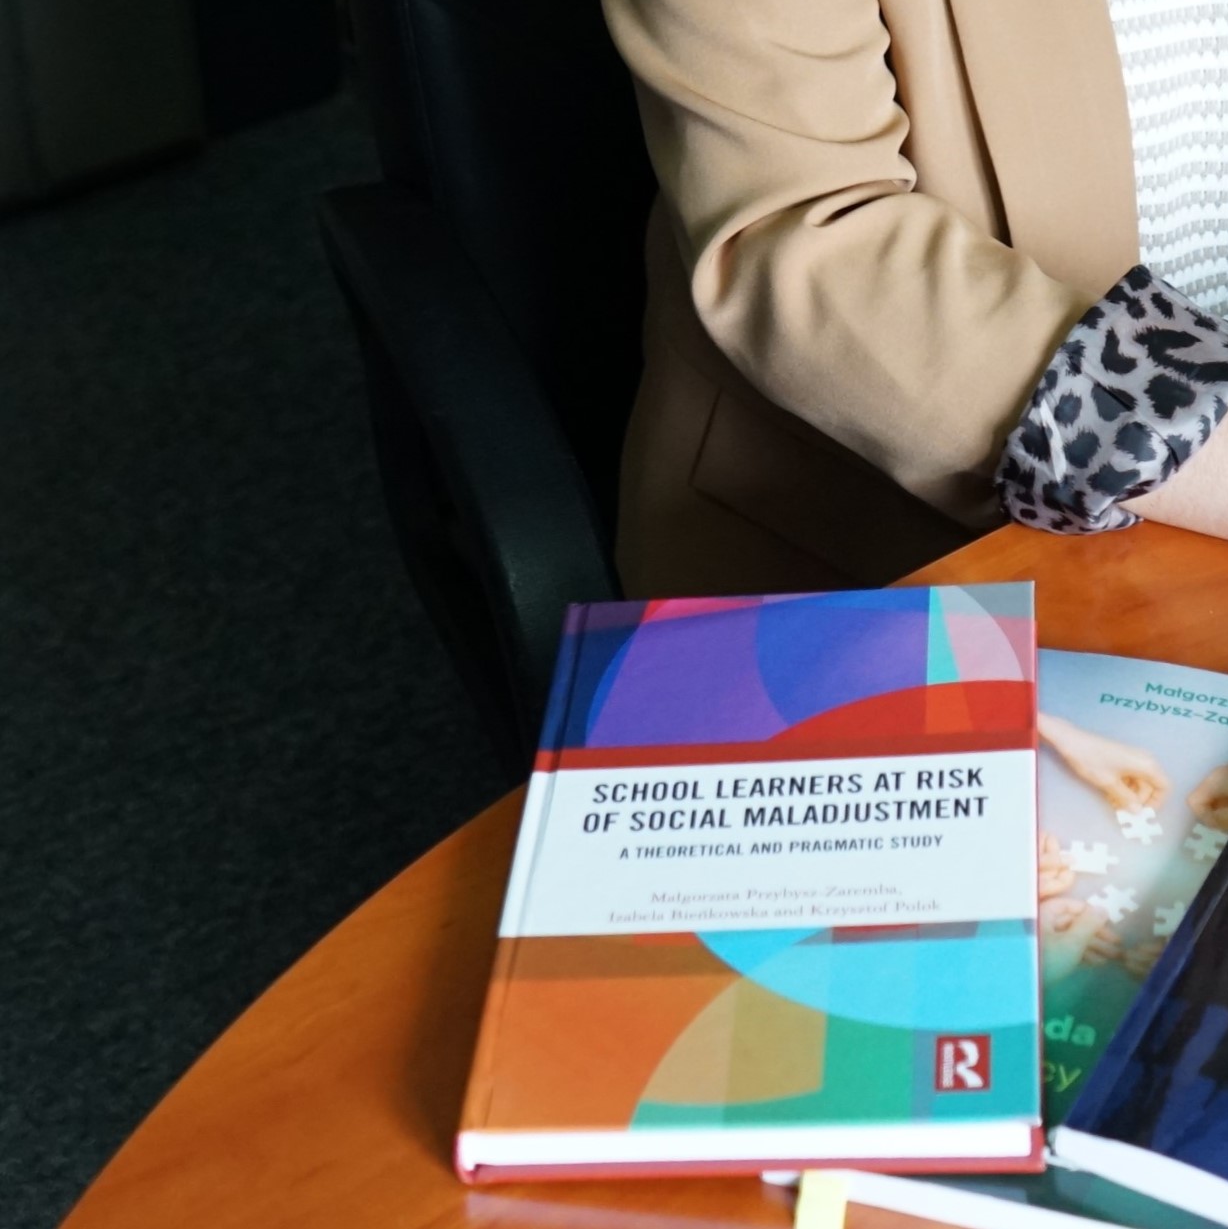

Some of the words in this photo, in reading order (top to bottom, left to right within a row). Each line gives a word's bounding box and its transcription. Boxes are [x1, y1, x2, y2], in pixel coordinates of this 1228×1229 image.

[592, 780, 705, 804] SCHOOL
[716, 773, 863, 799] LEARNERS
[873, 771, 905, 792] AT
[917, 767, 984, 790] RISK
[583, 811, 620, 833] OF
[629, 808, 732, 832] SOCIAL
[743, 796, 989, 827] MALADJUSTMENT
[619, 847, 630, 860] A
[636, 842, 744, 860] THEORETICAL
[750, 841, 783, 855] AND
[789, 837, 884, 854] PRAGMATIC
[890, 834, 944, 850] STUDY
[774, 904, 804, 918] and
